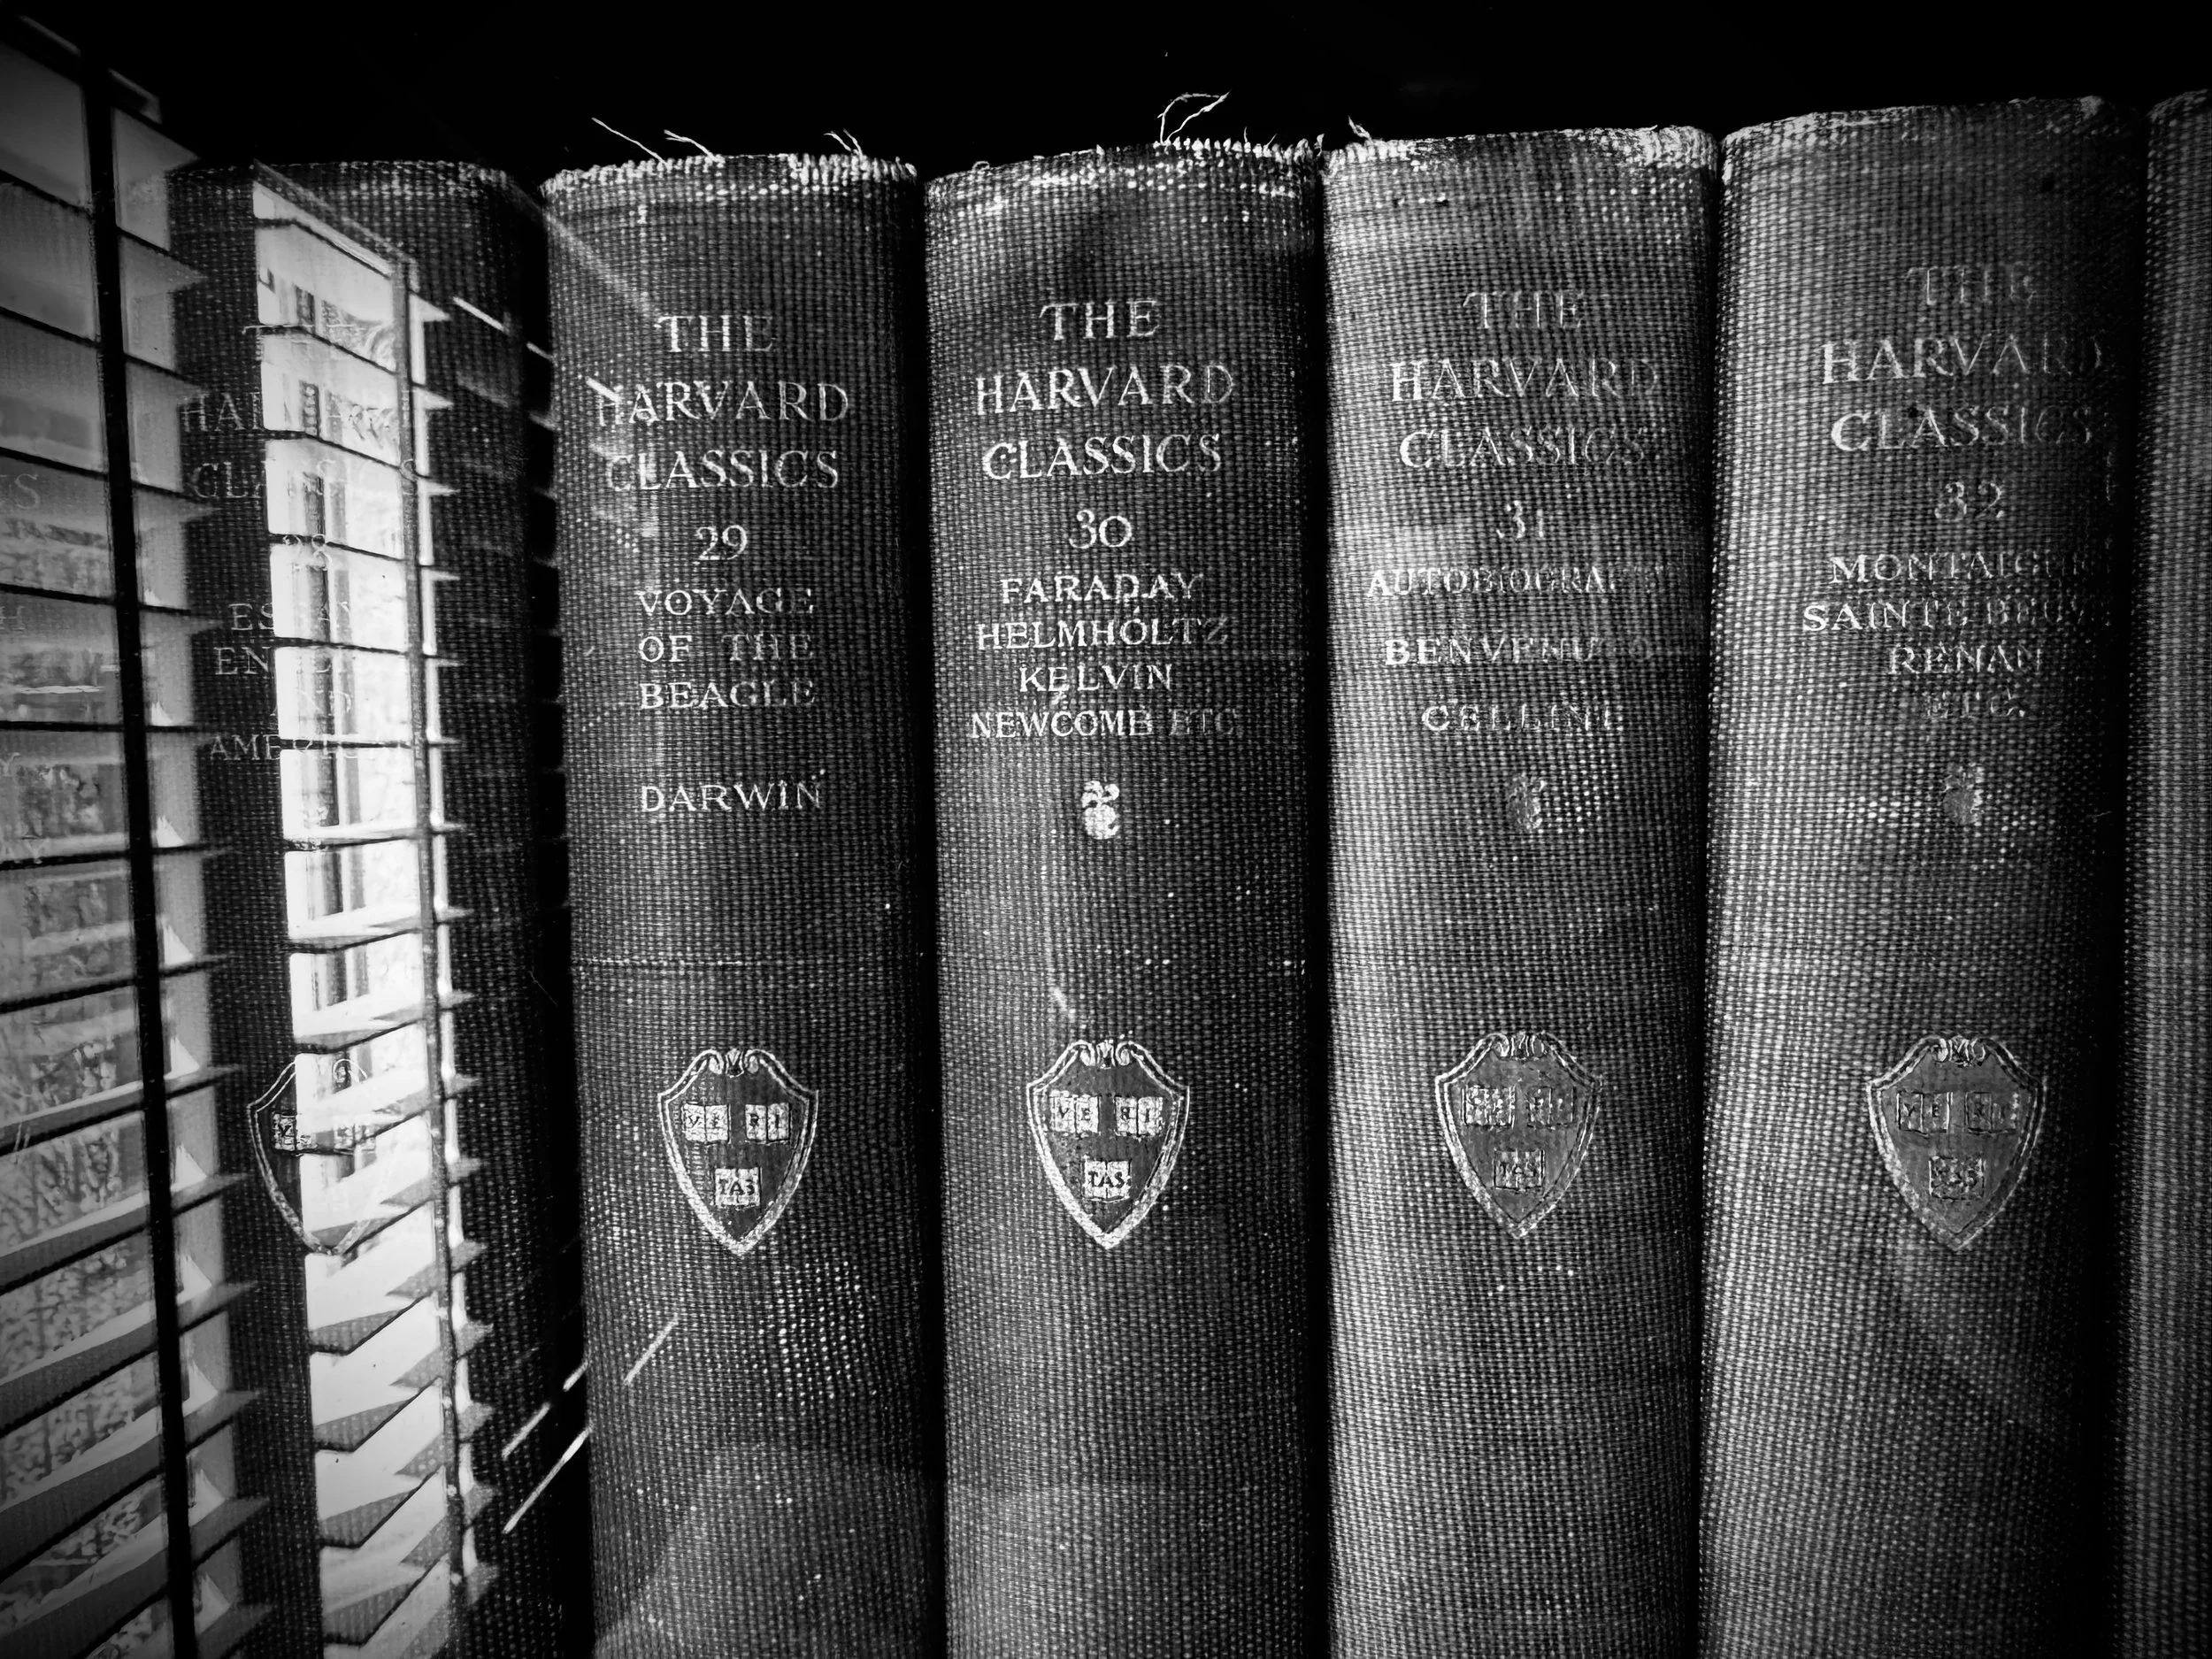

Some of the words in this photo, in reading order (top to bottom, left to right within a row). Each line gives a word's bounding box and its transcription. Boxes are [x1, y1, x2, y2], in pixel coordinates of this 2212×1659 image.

[1039, 300, 1160, 341] THE
[1462, 289, 1584, 329] THE
[654, 315, 773, 353] THE
[975, 364, 1234, 415] HARVARD
[1390, 357, 1657, 402] HARVARD
[594, 380, 849, 426] HARVARD
[982, 434, 1222, 480] CLASSICS
[1398, 426, 1645, 468] CLASSICS
[605, 449, 839, 489] CLASSICS
[1495, 500, 1545, 539] 31
[1934, 480, 2003, 524] 32
[695, 525, 749, 562] 29
[1068, 509, 1133, 549] 30
[634, 588, 814, 616] VOYAGE
[1000, 572, 1204, 604] FARADAY
[638, 634, 693, 663] OF
[721, 633, 815, 662] THE
[977, 617, 1229, 649] HELMHOLTZ
[1019, 664, 1172, 692] KELVIN
[1888, 645, 2042, 674] RENAN
[639, 680, 815, 710] BEAGLE
[972, 710, 1153, 739] NEWCOMB
[641, 780, 821, 812] DARWIN
